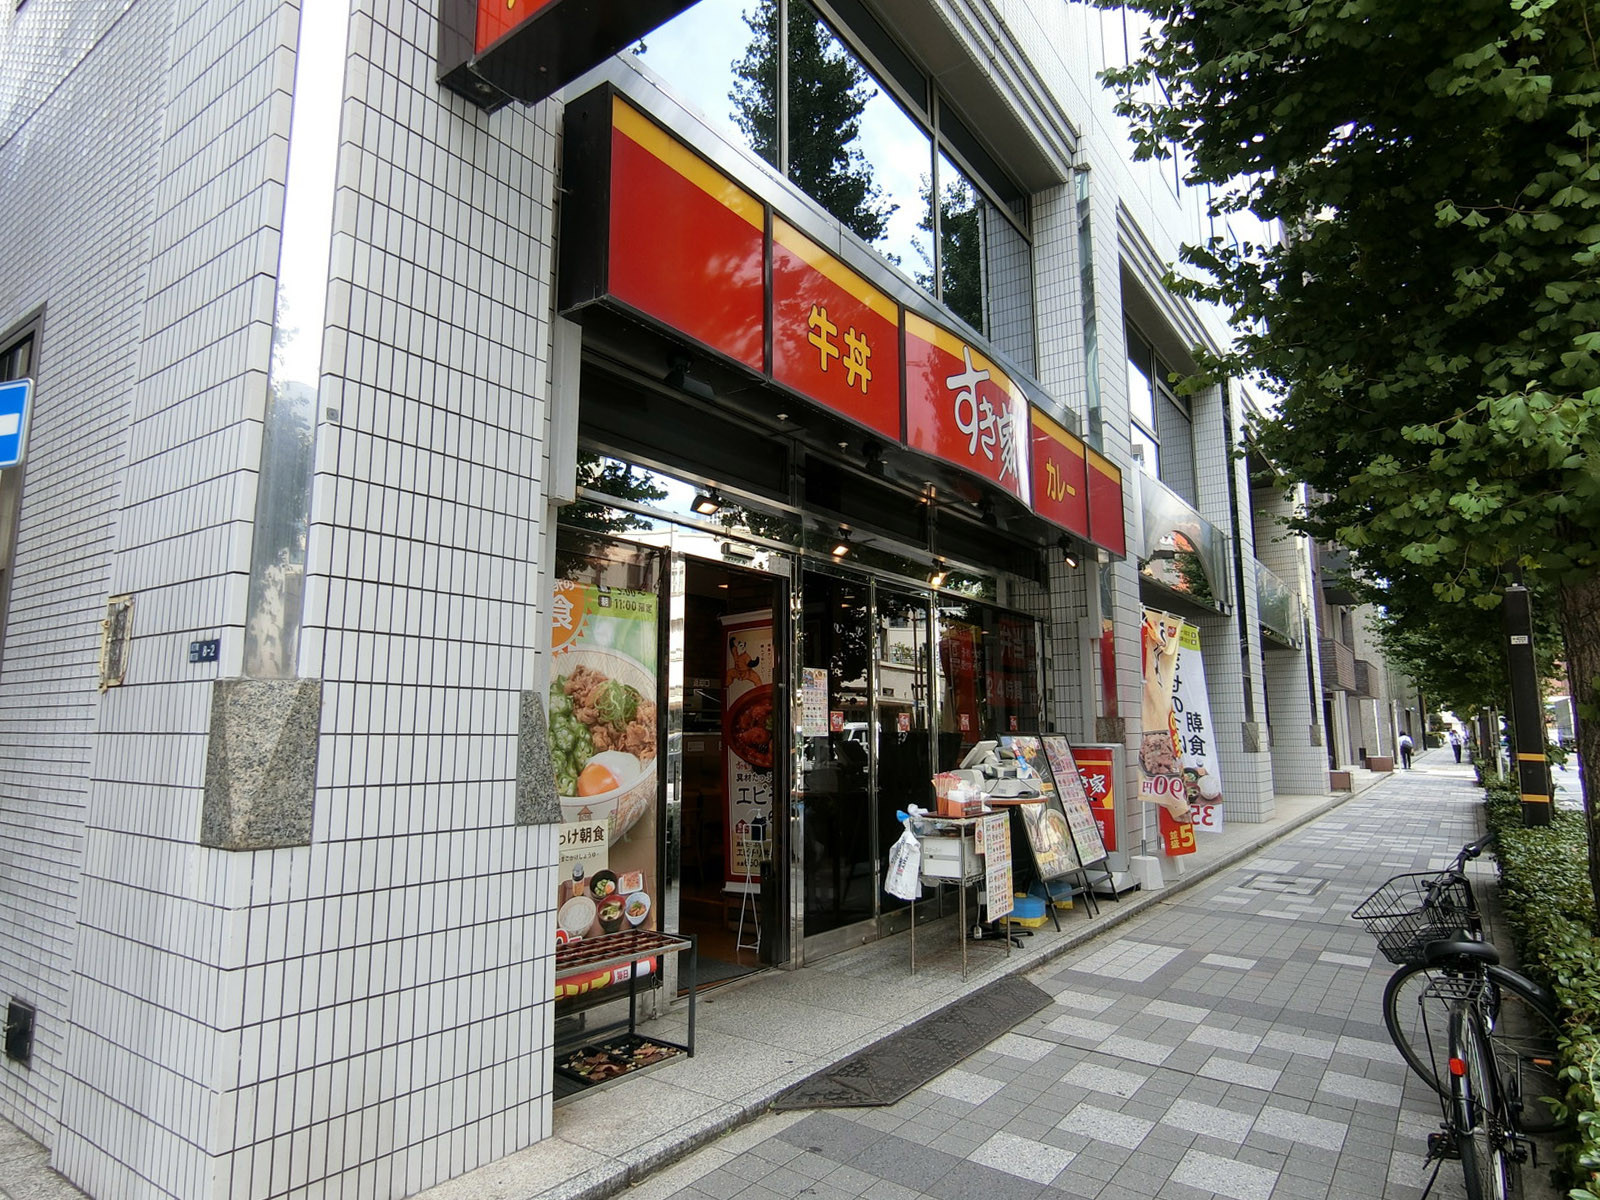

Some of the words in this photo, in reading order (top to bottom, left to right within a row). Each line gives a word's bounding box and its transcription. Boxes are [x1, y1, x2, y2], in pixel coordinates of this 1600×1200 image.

[808, 304, 872, 393] 牛丼
[946, 346, 1019, 481] すき家
[1046, 457, 1076, 502] カレー
[202, 644, 216, 657] 8-2
